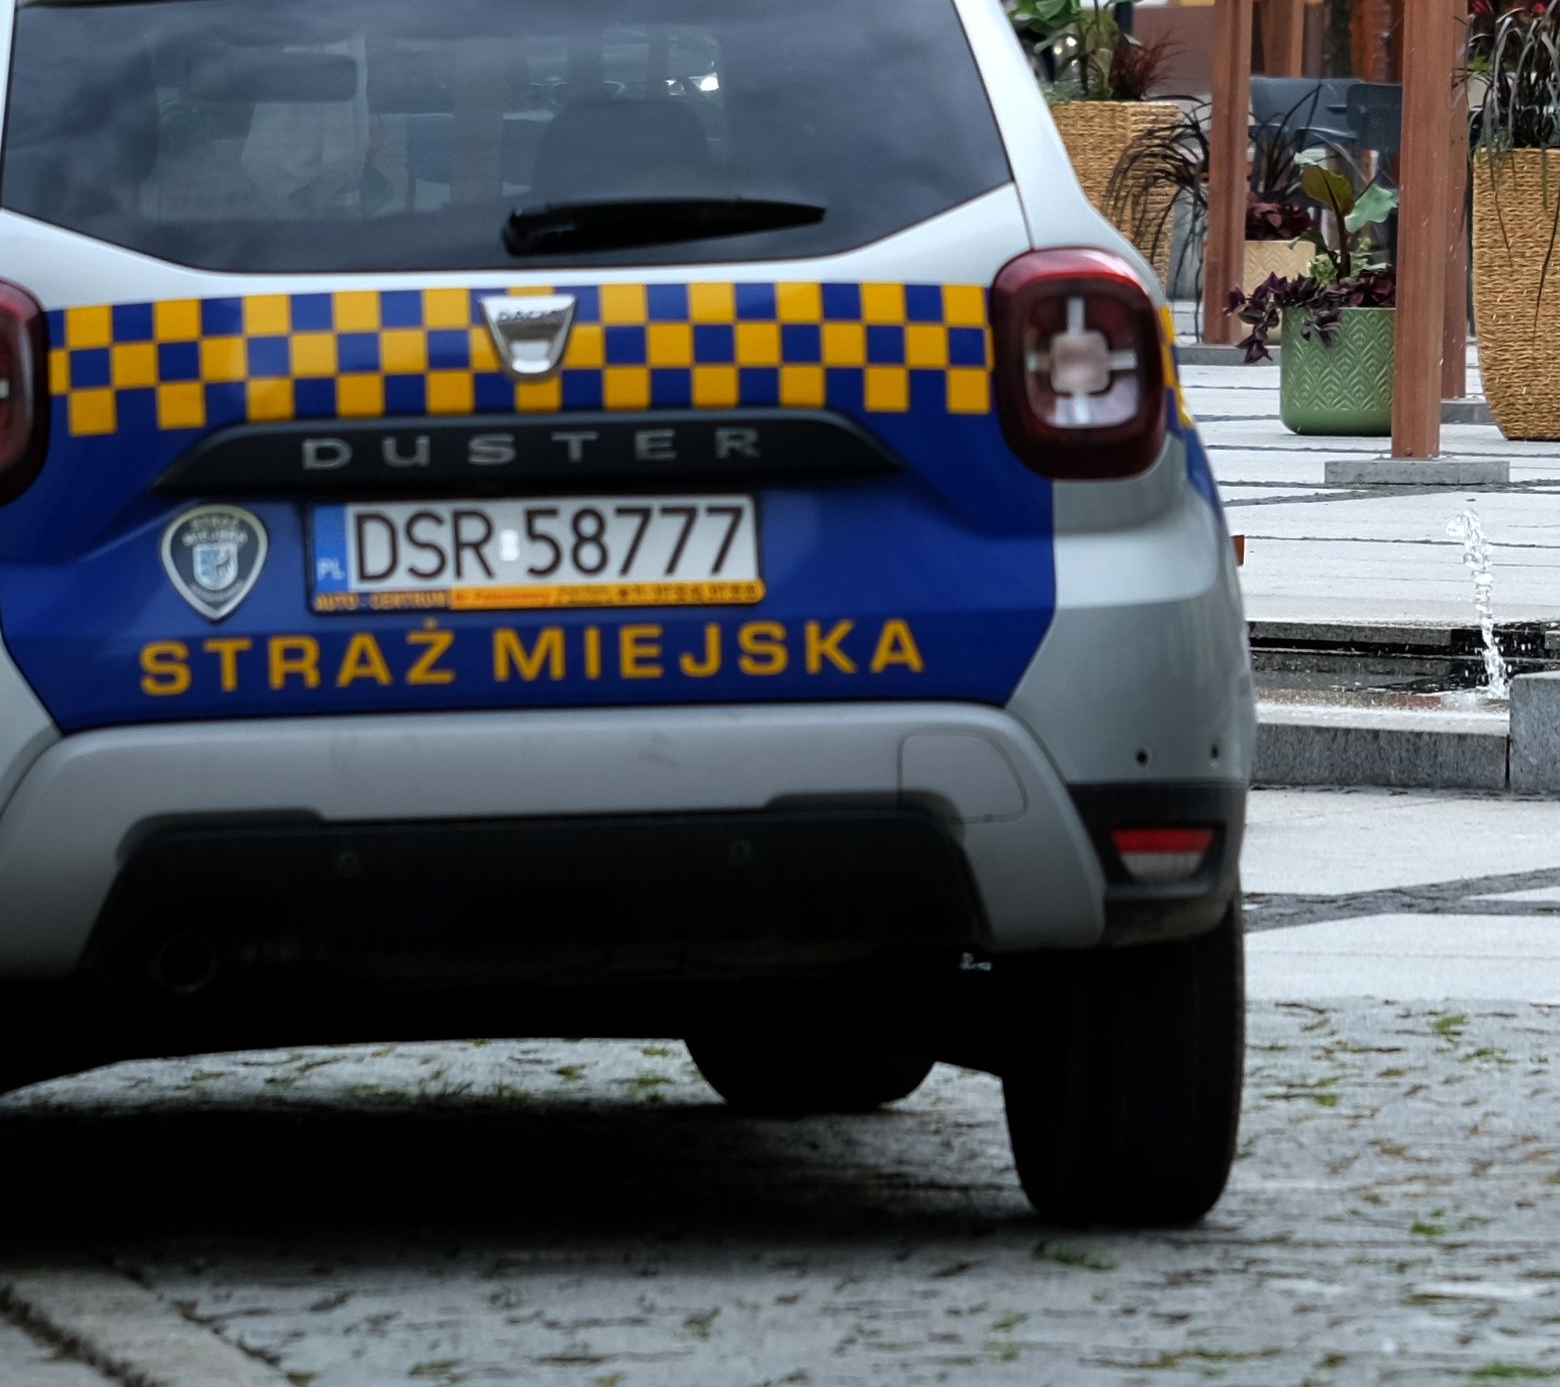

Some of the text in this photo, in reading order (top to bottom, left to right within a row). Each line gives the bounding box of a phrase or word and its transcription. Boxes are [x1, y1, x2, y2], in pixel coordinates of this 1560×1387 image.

[301, 427, 761, 470] DUSTER
[316, 557, 345, 580] PL
[354, 504, 745, 585] DSR 58777
[138, 618, 925, 696] STRAŻ MIEJSKA
